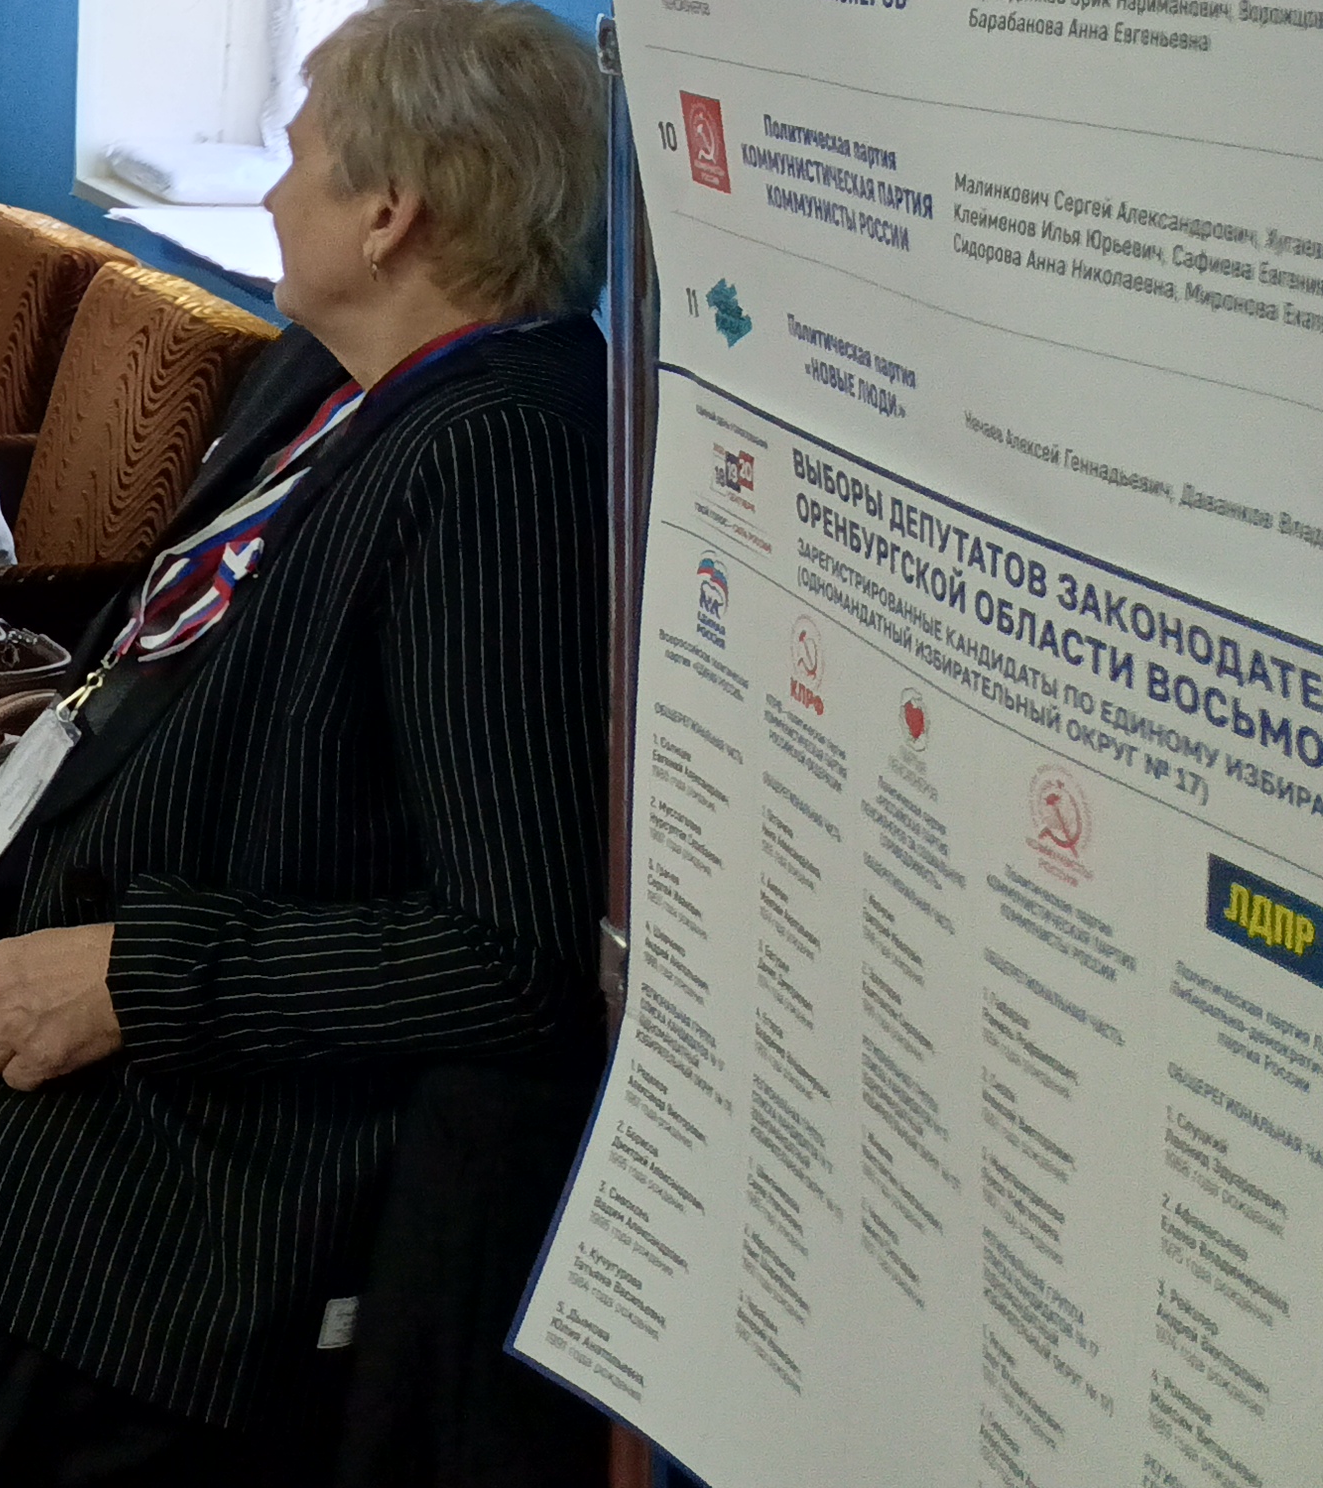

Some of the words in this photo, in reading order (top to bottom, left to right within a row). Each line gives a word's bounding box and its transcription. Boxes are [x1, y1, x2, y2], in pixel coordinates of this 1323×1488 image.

[969, 8, 1064, 37] Барабанова
[1068, 18, 1109, 42] Анна
[1113, 21, 1211, 52] Евгеньевна
[658, 121, 678, 152] 10
[763, 113, 850, 156] Политическая
[853, 140, 896, 171] партия
[741, 143, 875, 202] КОММУНИСТИЧЕСКАЯ
[878, 182, 933, 220] ПАРТИЯ
[954, 172, 1049, 208] Малинкович
[1054, 189, 1113, 220] Сергей
[766, 183, 855, 230] КОММУНИСТЫ
[859, 212, 909, 251] РОССИИ
[954, 203, 1037, 239] Клейменов
[1041, 220, 1080, 246] Илья
[954, 233, 1022, 268] Сидорова
[1026, 249, 1066, 277] Анна
[787, 313, 872, 369] Политическая
[874, 356, 916, 389] партия
[804, 357, 856, 398] «НОВЫЕ
[793, 447, 883, 521] ВЫБОРЫ
[889, 496, 1048, 599] ДЕПУТАТОВ
[1057, 572, 1323, 714] ЗАКОНОДАТЕ
[795, 492, 967, 614] ОРЕНБУРГСКОЙ
[975, 589, 1134, 690] ОБЛАСТИ
[1146, 662, 1323, 769] ВОСЬМО
[790, 677, 824, 716] КПРФ
[795, 565, 914, 656] (ОДНОМАНДАТНЫЙ
[915, 639, 1061, 736] ИЗБИРАТЕЛЬНЫЙ
[1066, 716, 1140, 771] ОКРУГ
[1175, 768, 1210, 808] 17)
[797, 538, 943, 640] ЗАРЕГИСТРИРОВАННЫЕ
[946, 619, 1058, 701] КАНДИДАТЫ
[1064, 686, 1096, 716] ПО
[1100, 701, 1219, 770] ЕДИНОМУ
[1225, 758, 1323, 819] ИЗБИРА
[1224, 881, 1315, 956] ЛДПР
